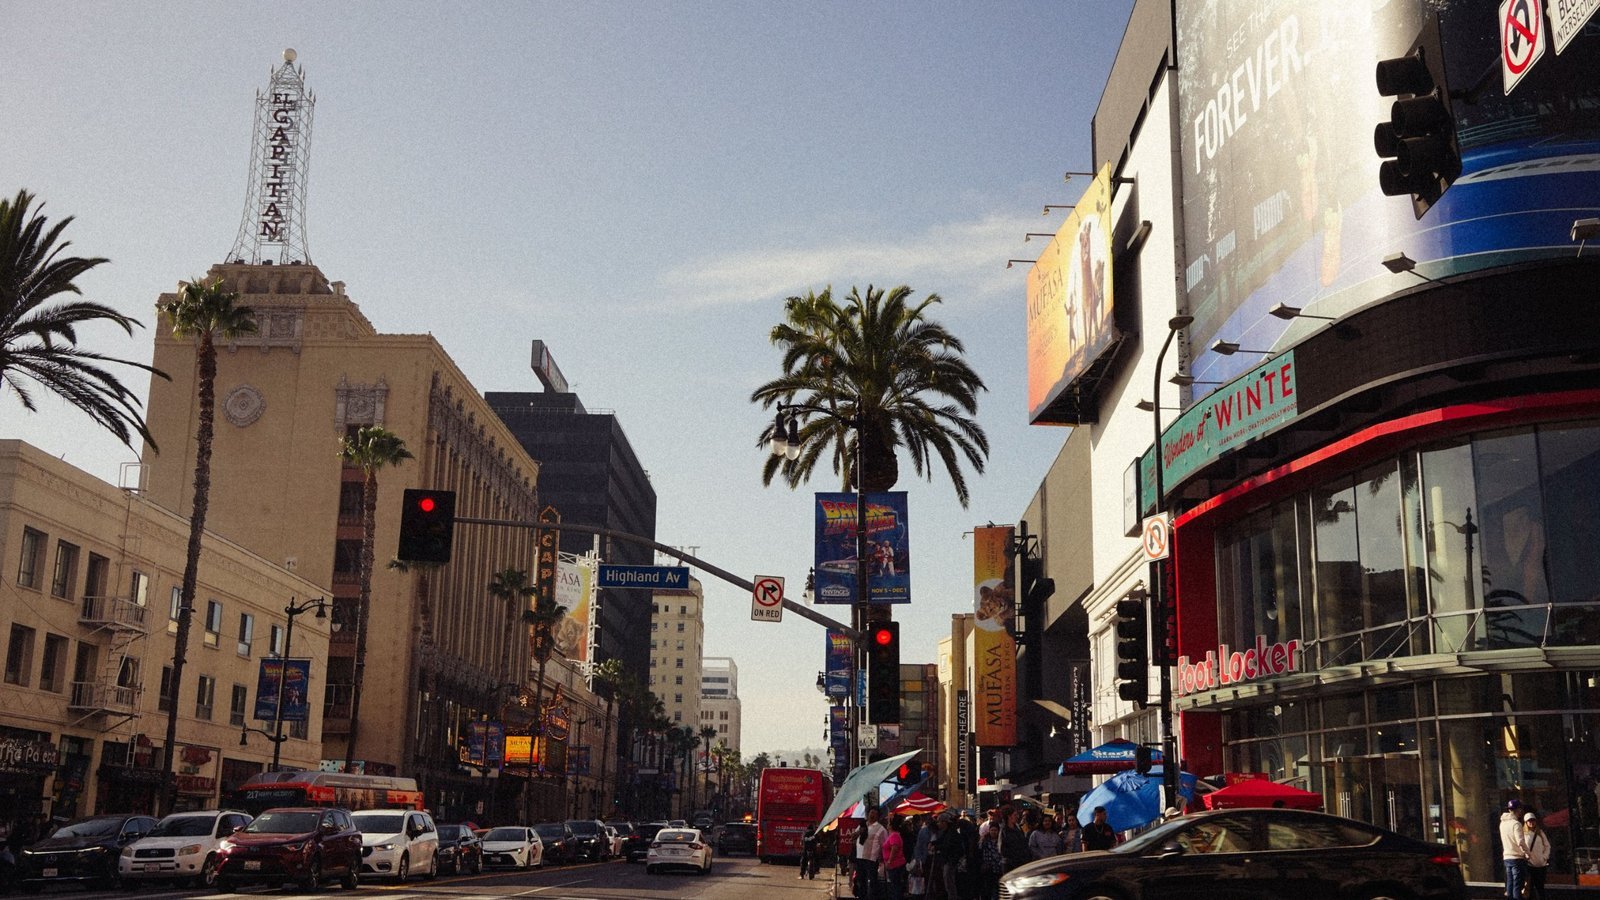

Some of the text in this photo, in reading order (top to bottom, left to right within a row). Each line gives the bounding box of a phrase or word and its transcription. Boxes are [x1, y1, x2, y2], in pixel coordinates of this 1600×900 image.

[1226, 23, 1246, 59] SEE
[1555, 0, 1598, 46] INTERSECTI
[271, 92, 291, 105] EL
[1194, 14, 1311, 175] FOREVER.
[260, 109, 289, 237] CAPITAN
[1029, 265, 1063, 321] MUFASA
[556, 572, 581, 588] FASA
[606, 569, 681, 585] Highland Av
[754, 609, 780, 618] ON RED
[1178, 634, 1301, 695] Foot Locker
[985, 643, 1002, 728] MUFASA
[958, 695, 967, 770] DOLBY THEATRE
[1004, 705, 1012, 728] THE
[1092, 749, 1136, 759] StarLi
[246, 790, 259, 800] 217
